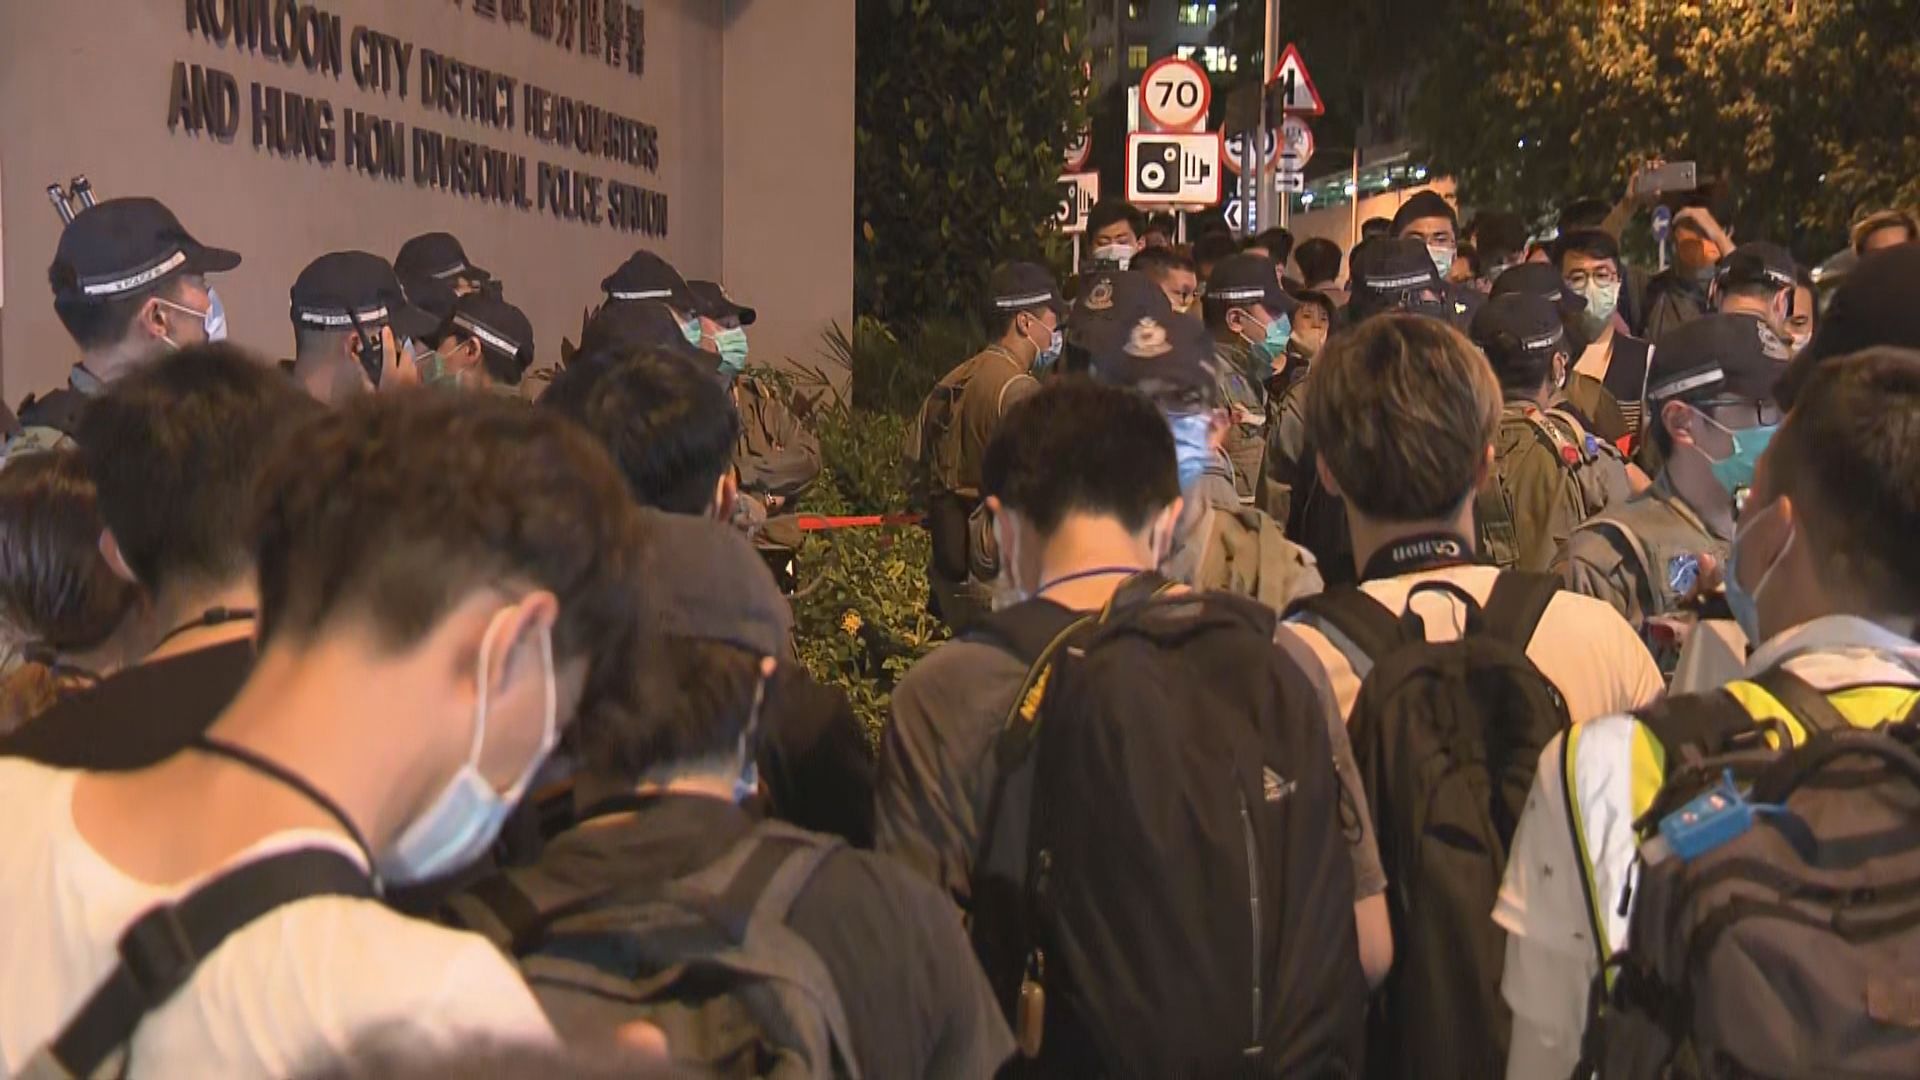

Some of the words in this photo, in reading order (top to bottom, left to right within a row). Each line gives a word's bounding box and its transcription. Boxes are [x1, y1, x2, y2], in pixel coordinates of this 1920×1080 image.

[351, 25, 413, 100] CITY
[420, 48, 518, 130] DISTRICT
[524, 84, 660, 172] HEADQUARTERS
[1155, 82, 1198, 108] 70
[168, 59, 240, 141] AND
[251, 81, 336, 162] HUNG
[344, 108, 405, 184] HOM
[412, 126, 532, 212] DIVISIONAL
[538, 161, 603, 224] POLICE
[607, 179, 669, 238] STATION
[1392, 540, 1461, 562] Canon
